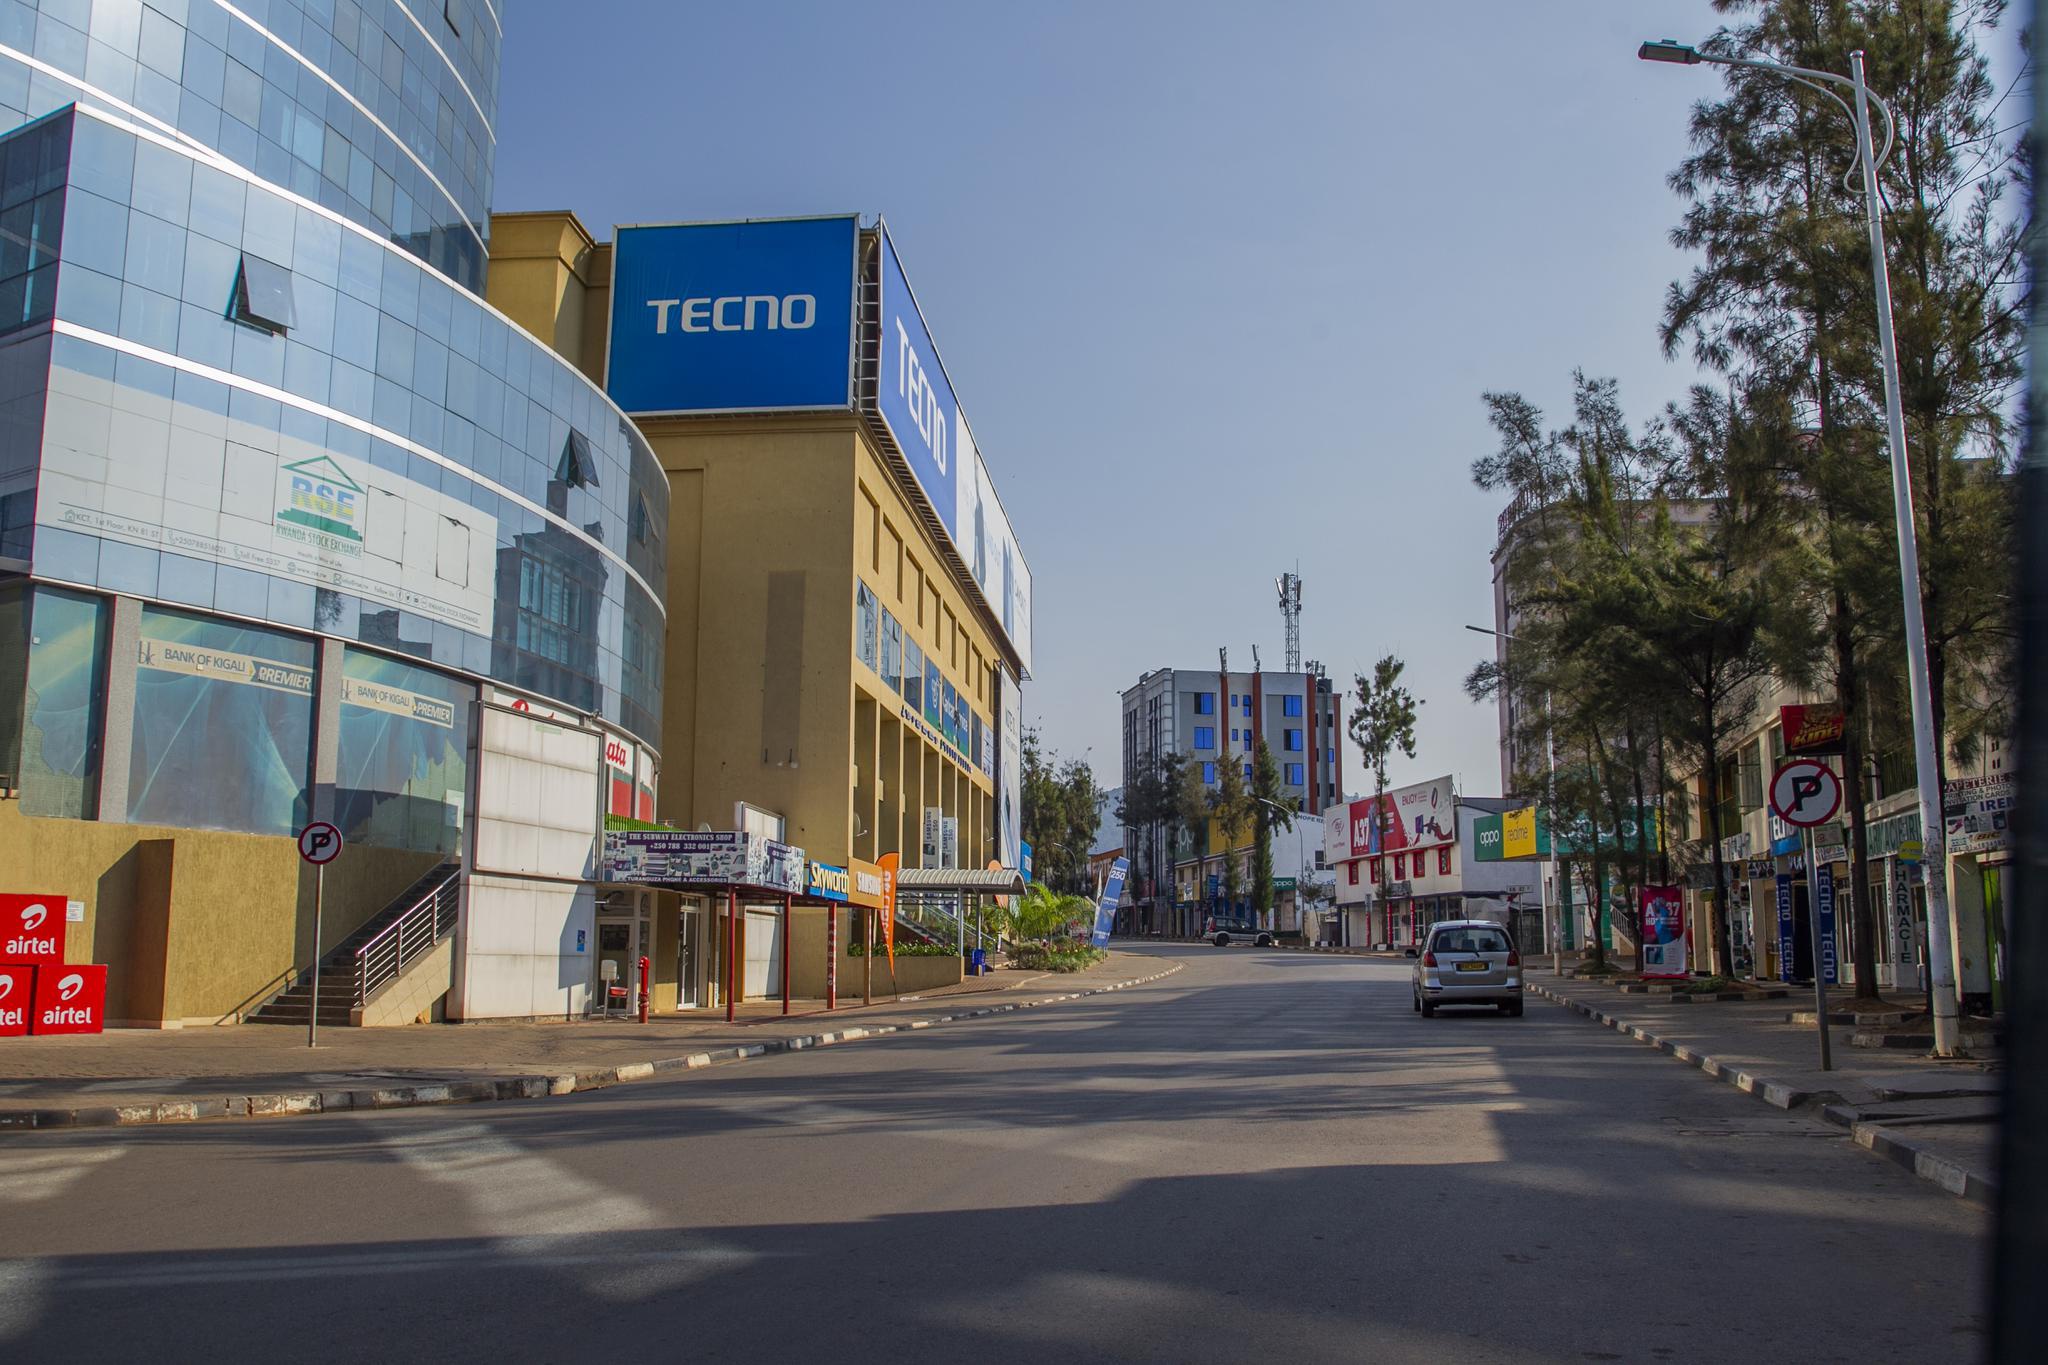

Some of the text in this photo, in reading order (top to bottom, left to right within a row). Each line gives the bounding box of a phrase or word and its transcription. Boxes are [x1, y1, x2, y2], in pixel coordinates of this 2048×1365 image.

[647, 294, 816, 334] TECNO
[896, 316, 947, 477] TECNO
[290, 476, 355, 521] RSE
[275, 524, 306, 541] RWANDA
[308, 532, 329, 547] STOCK
[330, 536, 362, 557] EXCHANGE
[164, 648, 195, 664] BANK
[196, 654, 212, 666] OF
[213, 657, 246, 672] KIGALI
[257, 666, 312, 690] PREMIER
[357, 686, 378, 700] BANK
[379, 692, 388, 702] OF
[388, 693, 410, 707] KIGALI
[416, 701, 451, 722] PREMIER
[1402, 793, 1417, 806] ENJOY
[311, 832, 331, 857] P
[629, 833, 641, 841] THE
[643, 833, 669, 841] SUBWAY
[671, 833, 714, 841] ELECTRONICS
[1353, 817, 1370, 849] A37
[1480, 829, 1500, 848] oppo
[1507, 825, 1530, 842] realme
[811, 862, 850, 897] Skyworth
[857, 871, 881, 897] SAMSUNG
[1110, 870, 1126, 881] 250
[1272, 880, 1293, 888] oppo
[1818, 865, 1832, 914] TECNO
[1780, 881, 1792, 921] TECNO
[1894, 858, 1913, 964] PHARMACIE
[6, 937, 56, 955] airtel
[1822, 929, 1836, 980] TECNO
[42, 1005, 92, 1025] airtel
